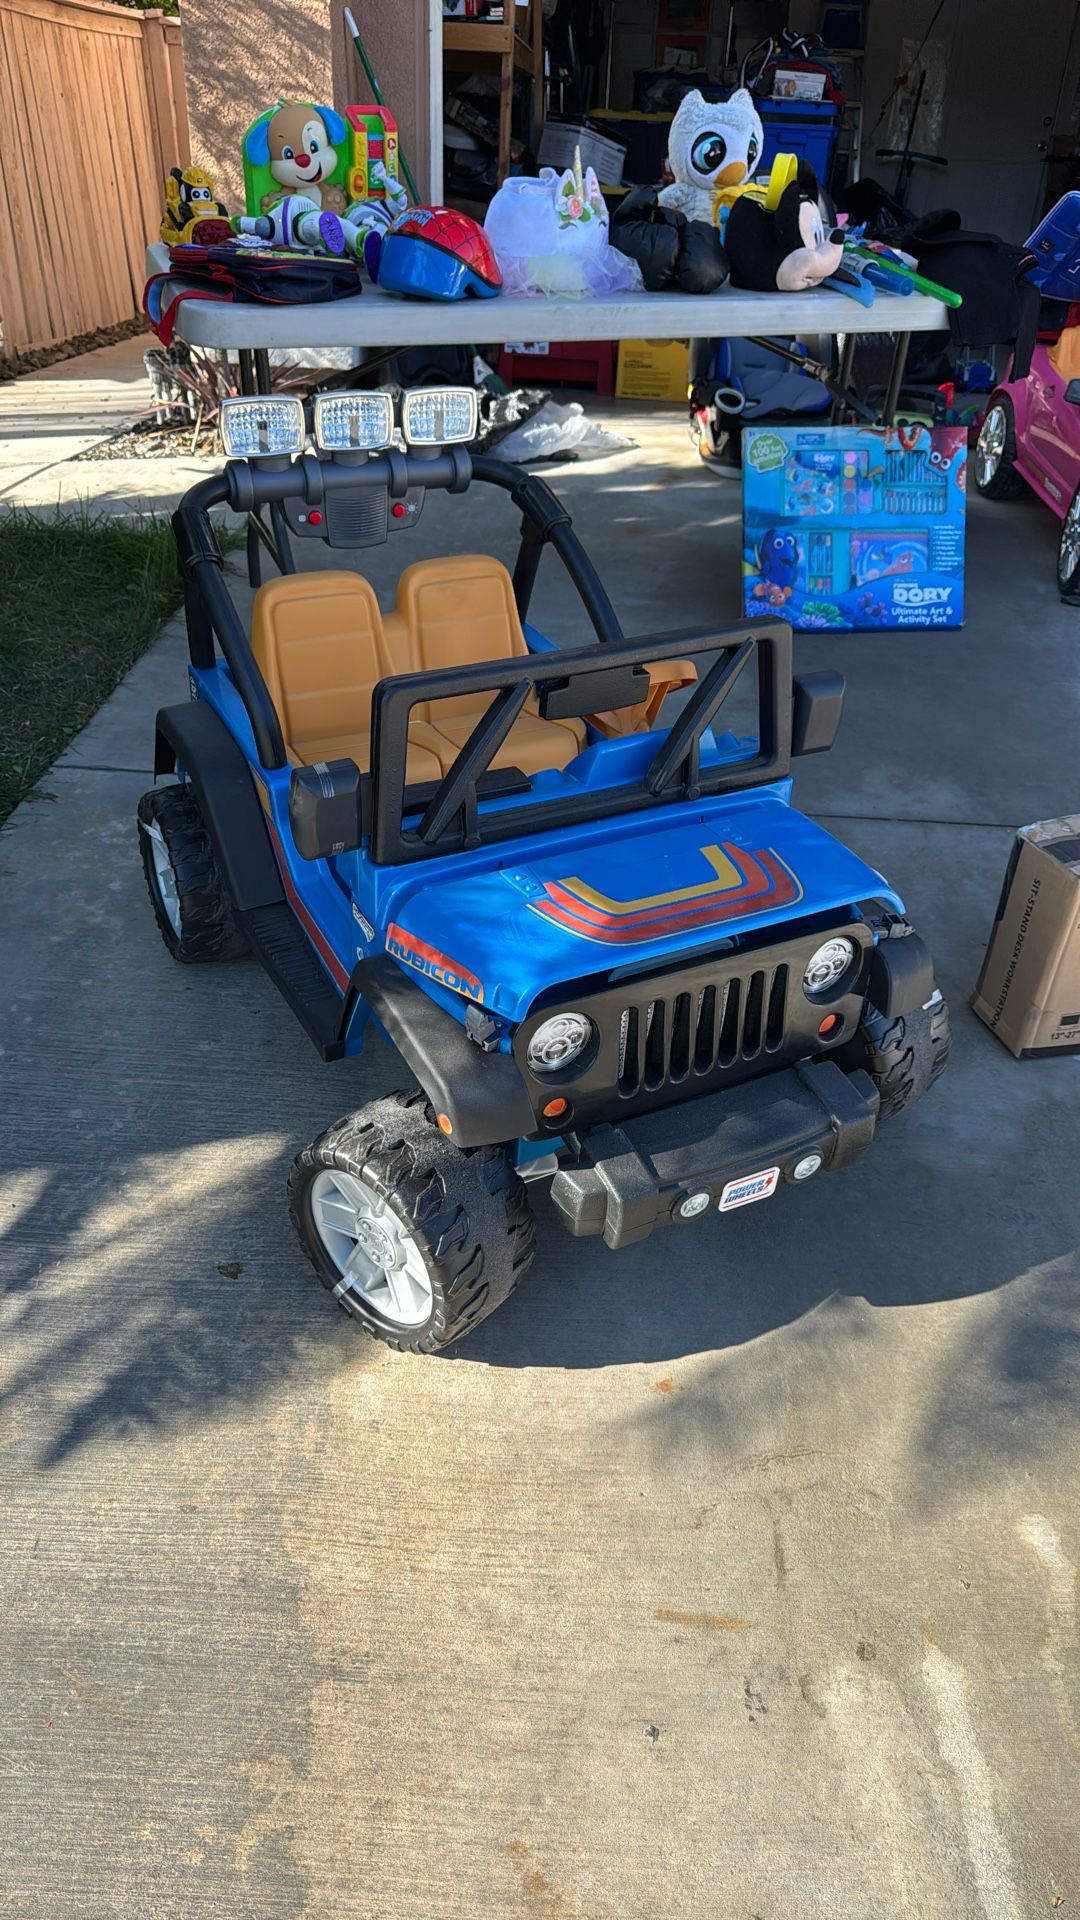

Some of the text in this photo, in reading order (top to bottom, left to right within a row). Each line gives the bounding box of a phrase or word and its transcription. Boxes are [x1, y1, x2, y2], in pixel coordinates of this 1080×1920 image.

[893, 586, 953, 603] DORY
[891, 605, 953, 616] Ultimate Art &
[897, 614, 948, 626] Activity Set
[991, 878, 1041, 1029] SIT-STAND DESK WORKSTATION
[387, 938, 480, 999] RUBICON
[724, 1186, 765, 1204] WHEELS
[728, 1178, 765, 1196] POWER
